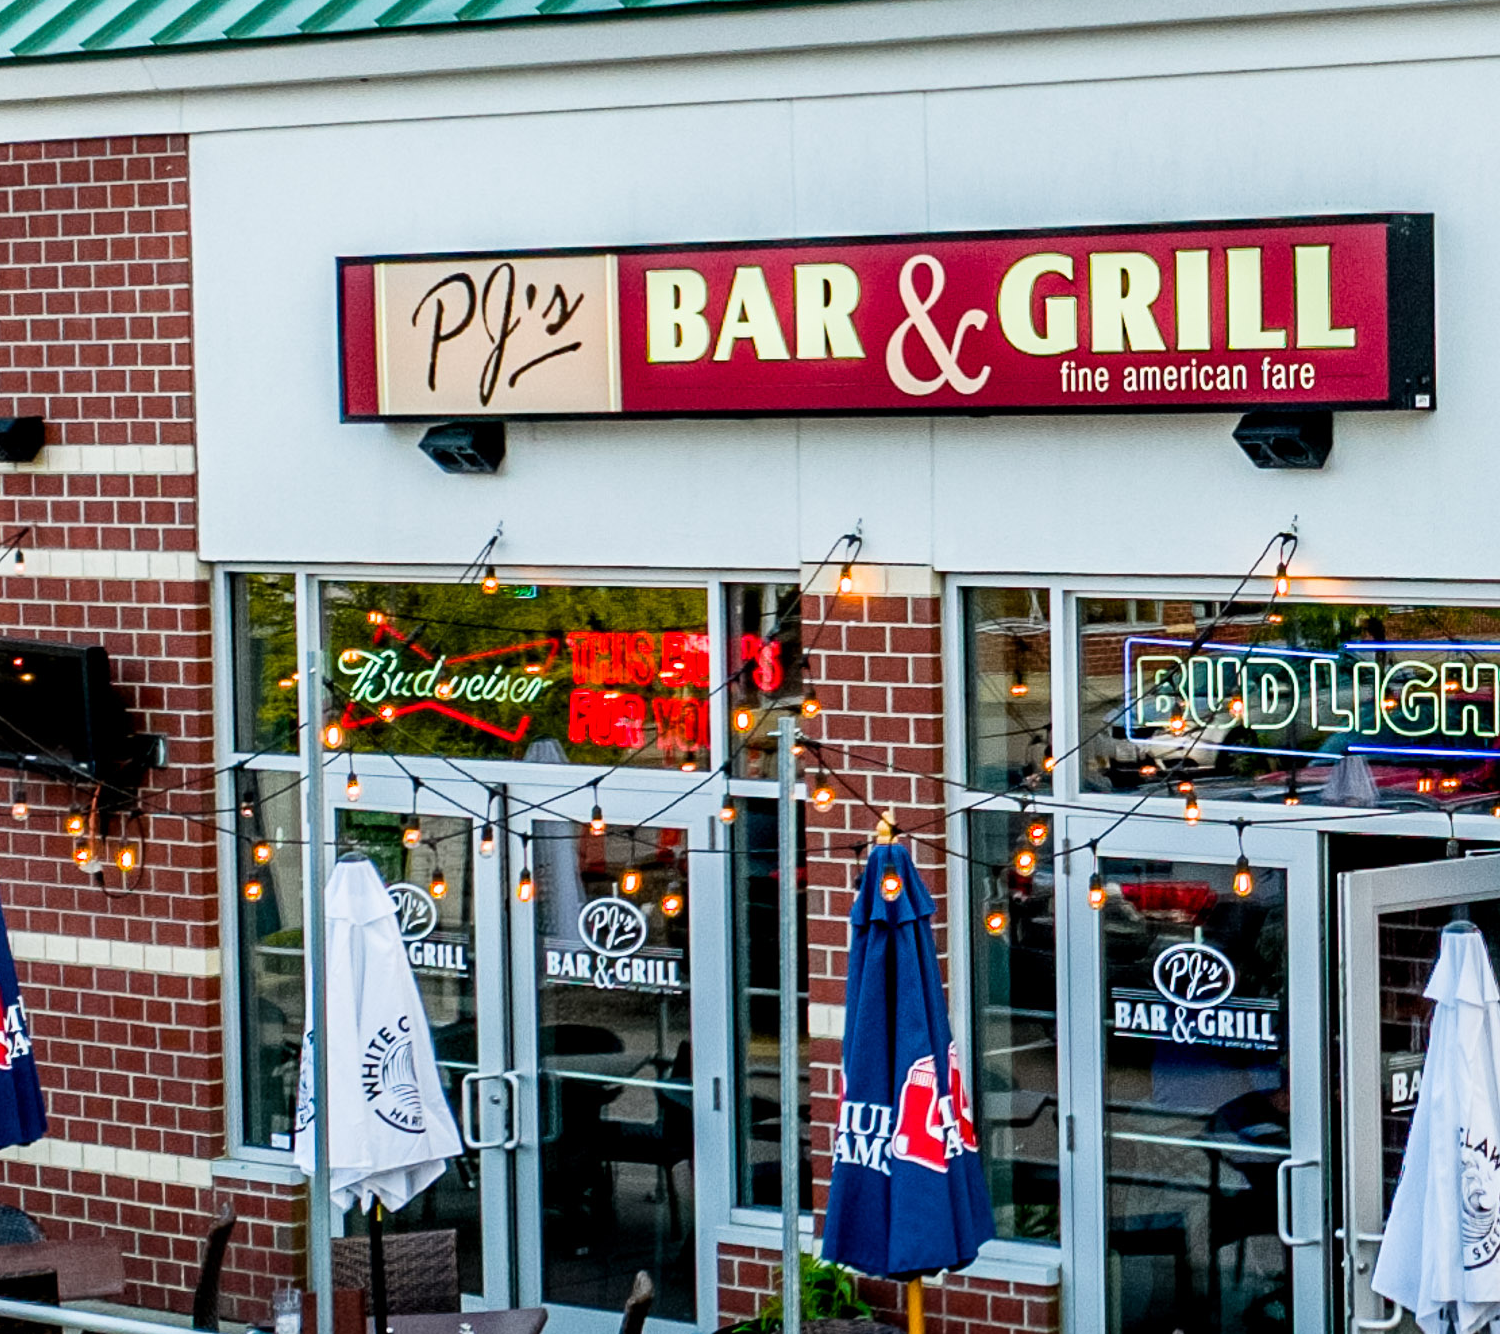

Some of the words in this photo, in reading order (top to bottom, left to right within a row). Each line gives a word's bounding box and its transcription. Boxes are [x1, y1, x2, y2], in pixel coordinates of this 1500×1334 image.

[411, 262, 585, 407] PJ's
[644, 262, 866, 364] BAR
[885, 253, 992, 397] &
[997, 244, 1357, 357] GRILL
[1059, 361, 1110, 393] fine
[1123, 358, 1248, 393] american
[1261, 356, 1315, 390] fare
[338, 649, 554, 704] Budweiser
[565, 630, 655, 686] THIS
[1136, 655, 1300, 731] BUD
[588, 905, 638, 950] PJ's
[408, 941, 467, 971] GRILL
[546, 950, 592, 979] BAR
[593, 954, 616, 990] &
[615, 957, 681, 987] GRILL
[1165, 952, 1223, 1001] PJ's
[1114, 1000, 1168, 1032] BAR
[1172, 1006, 1197, 1045] &
[1197, 1008, 1276, 1042] GRILL
[362, 1026, 397, 1102] WHITE
[1392, 1069, 1422, 1104] BA
